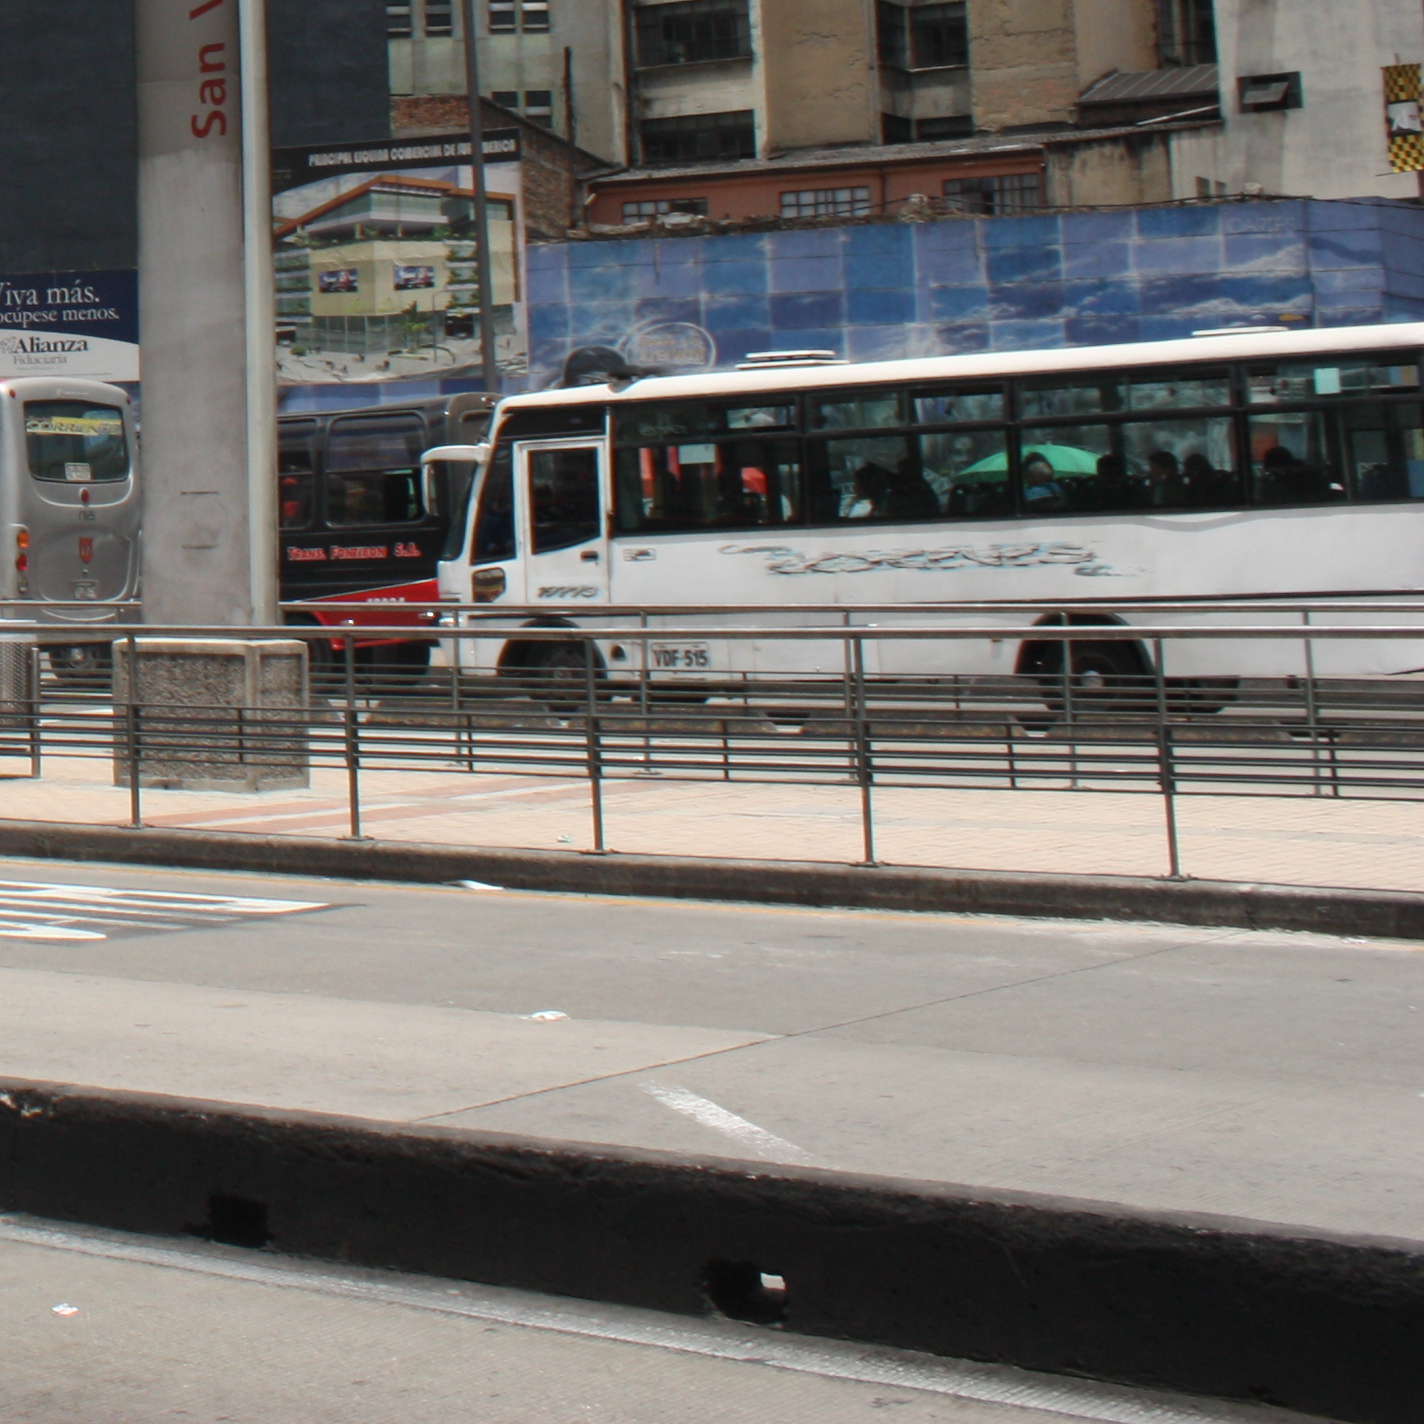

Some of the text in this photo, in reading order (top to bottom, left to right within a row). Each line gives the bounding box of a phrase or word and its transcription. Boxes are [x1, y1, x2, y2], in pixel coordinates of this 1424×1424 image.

[190, 41, 227, 139] San
[46, 279, 100, 305] más.
[62, 307, 120, 322] menos.
[13, 336, 89, 354] Alianza
